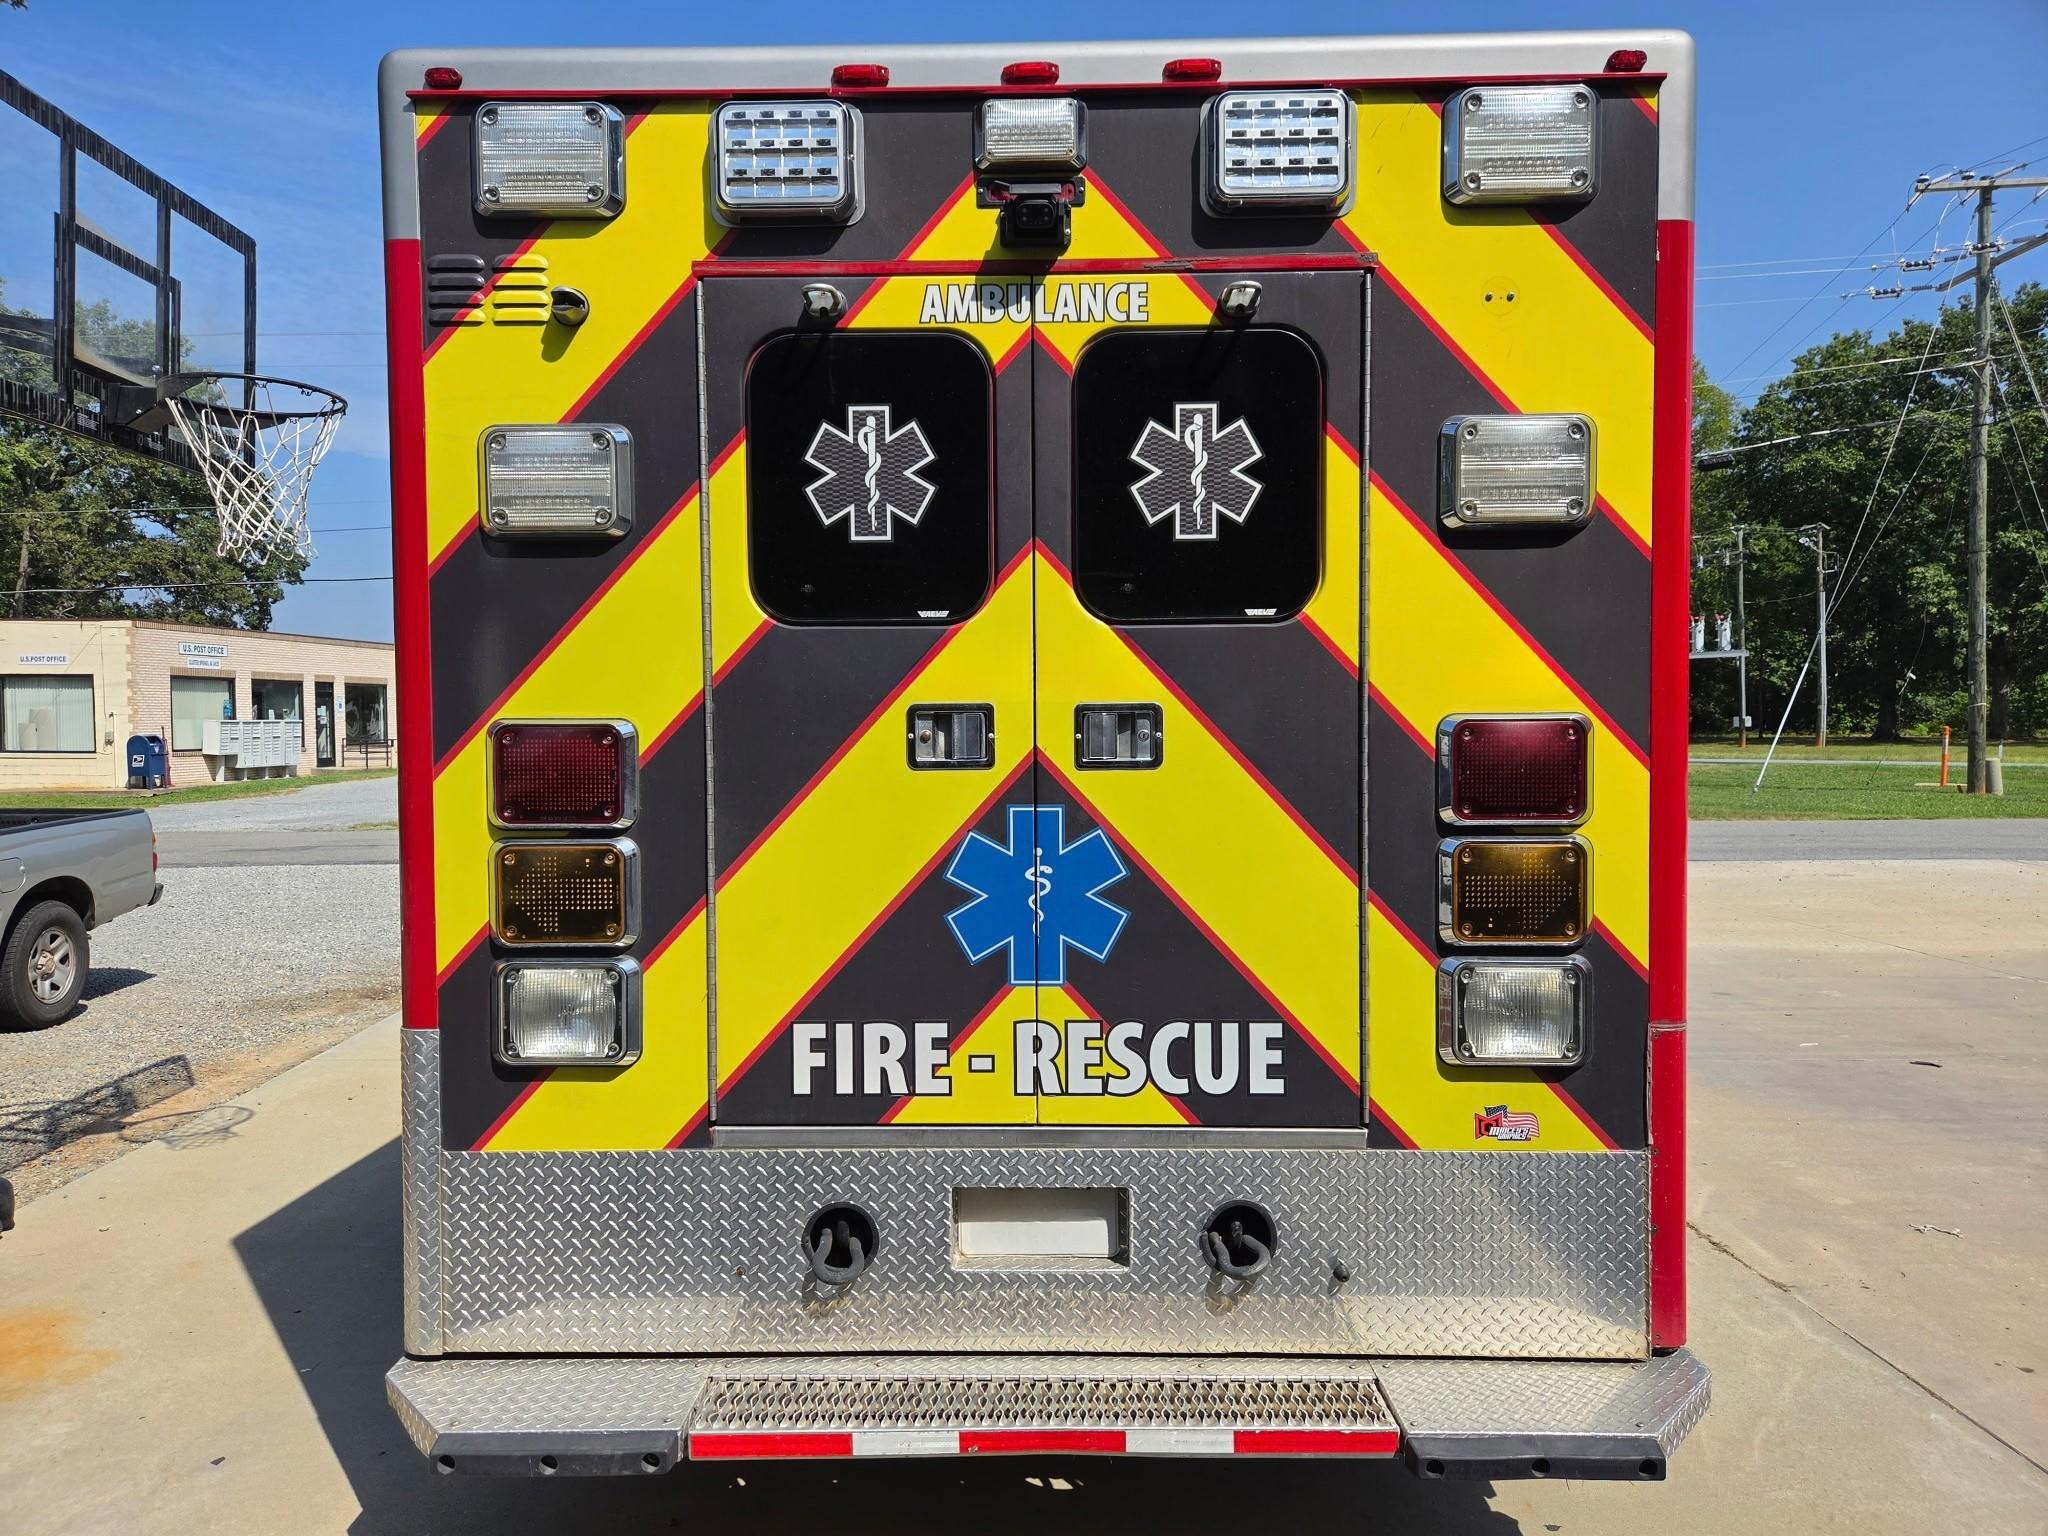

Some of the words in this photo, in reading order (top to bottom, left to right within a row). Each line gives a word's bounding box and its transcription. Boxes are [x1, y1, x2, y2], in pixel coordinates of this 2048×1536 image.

[919, 282, 1149, 324] AMBULANCE
[46, 655, 66, 663] OFFICE
[193, 645, 206, 654] POST
[207, 646, 224, 655] OFFICE
[791, 1021, 952, 1096] FIRE
[1013, 1020, 1287, 1096] RESCUE
